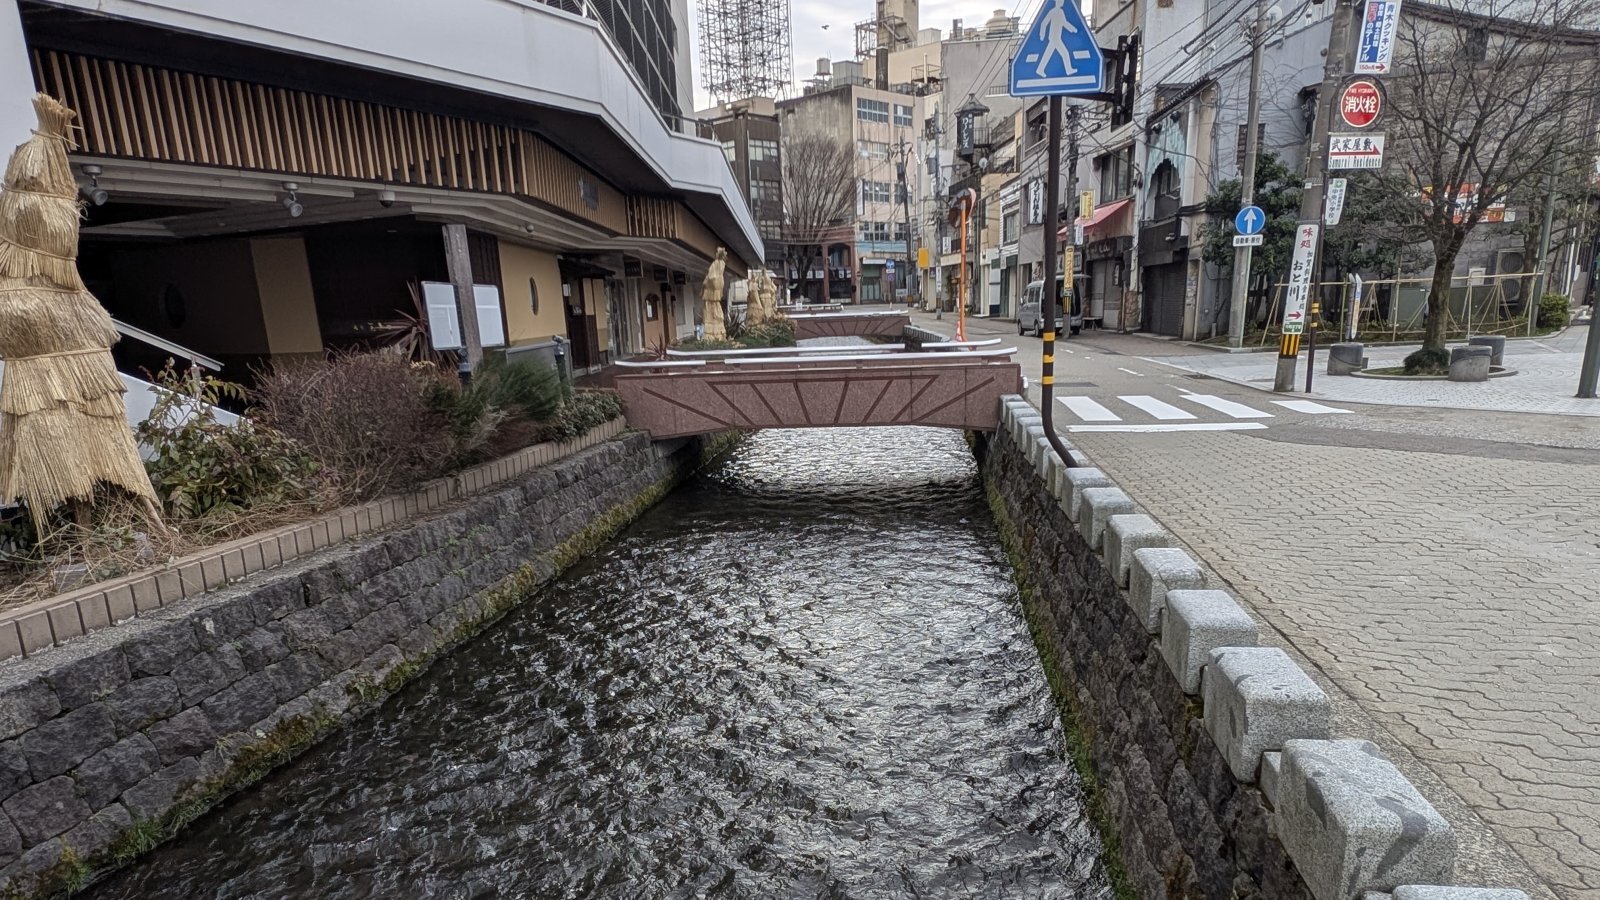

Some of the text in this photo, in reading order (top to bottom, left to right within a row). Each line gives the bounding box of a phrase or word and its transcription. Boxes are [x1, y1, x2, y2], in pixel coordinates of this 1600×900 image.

[1378, 4, 1395, 61] 青木クッキング
[1345, 95, 1377, 113] 消火栓
[1331, 138, 1372, 151] 武家屋敷
[1289, 227, 1313, 301] 味処 おと川
